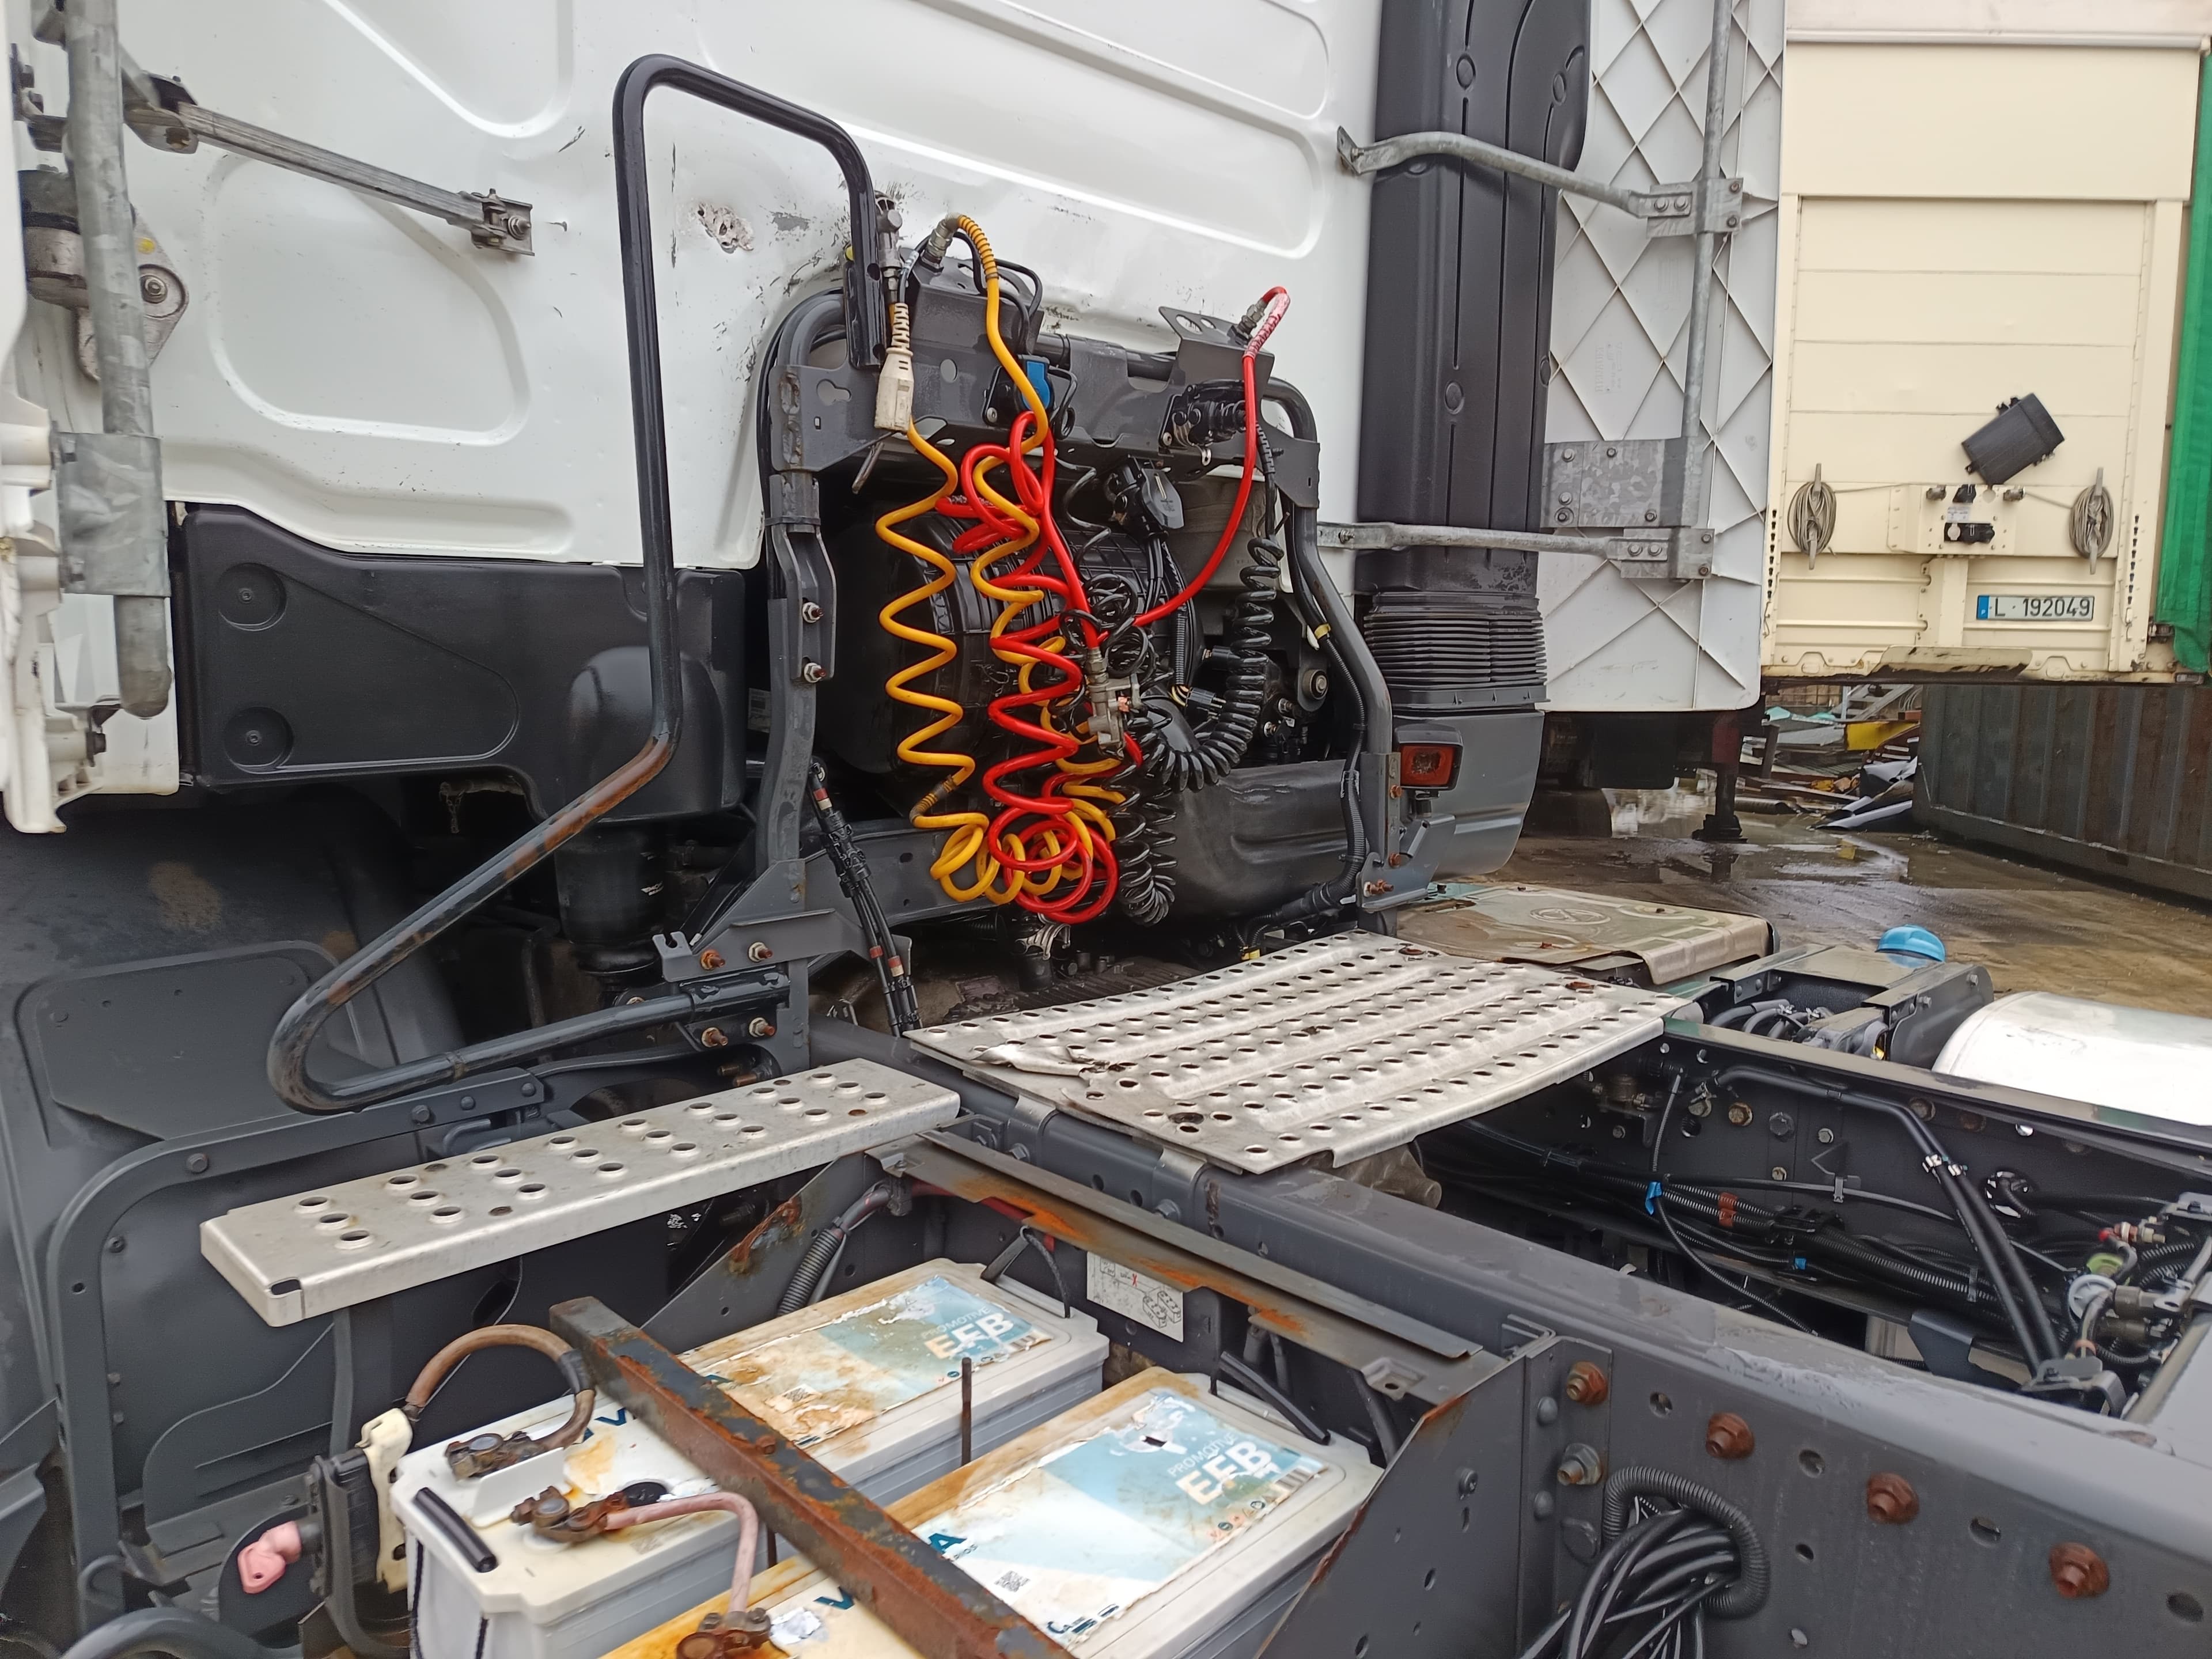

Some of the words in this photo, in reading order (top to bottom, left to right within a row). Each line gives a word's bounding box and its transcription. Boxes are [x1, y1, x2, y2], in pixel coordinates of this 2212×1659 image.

[1995, 597, 2006, 616] L
[2022, 597, 2090, 616] 192049
[1167, 1432, 1237, 1477] PROMOTIVE
